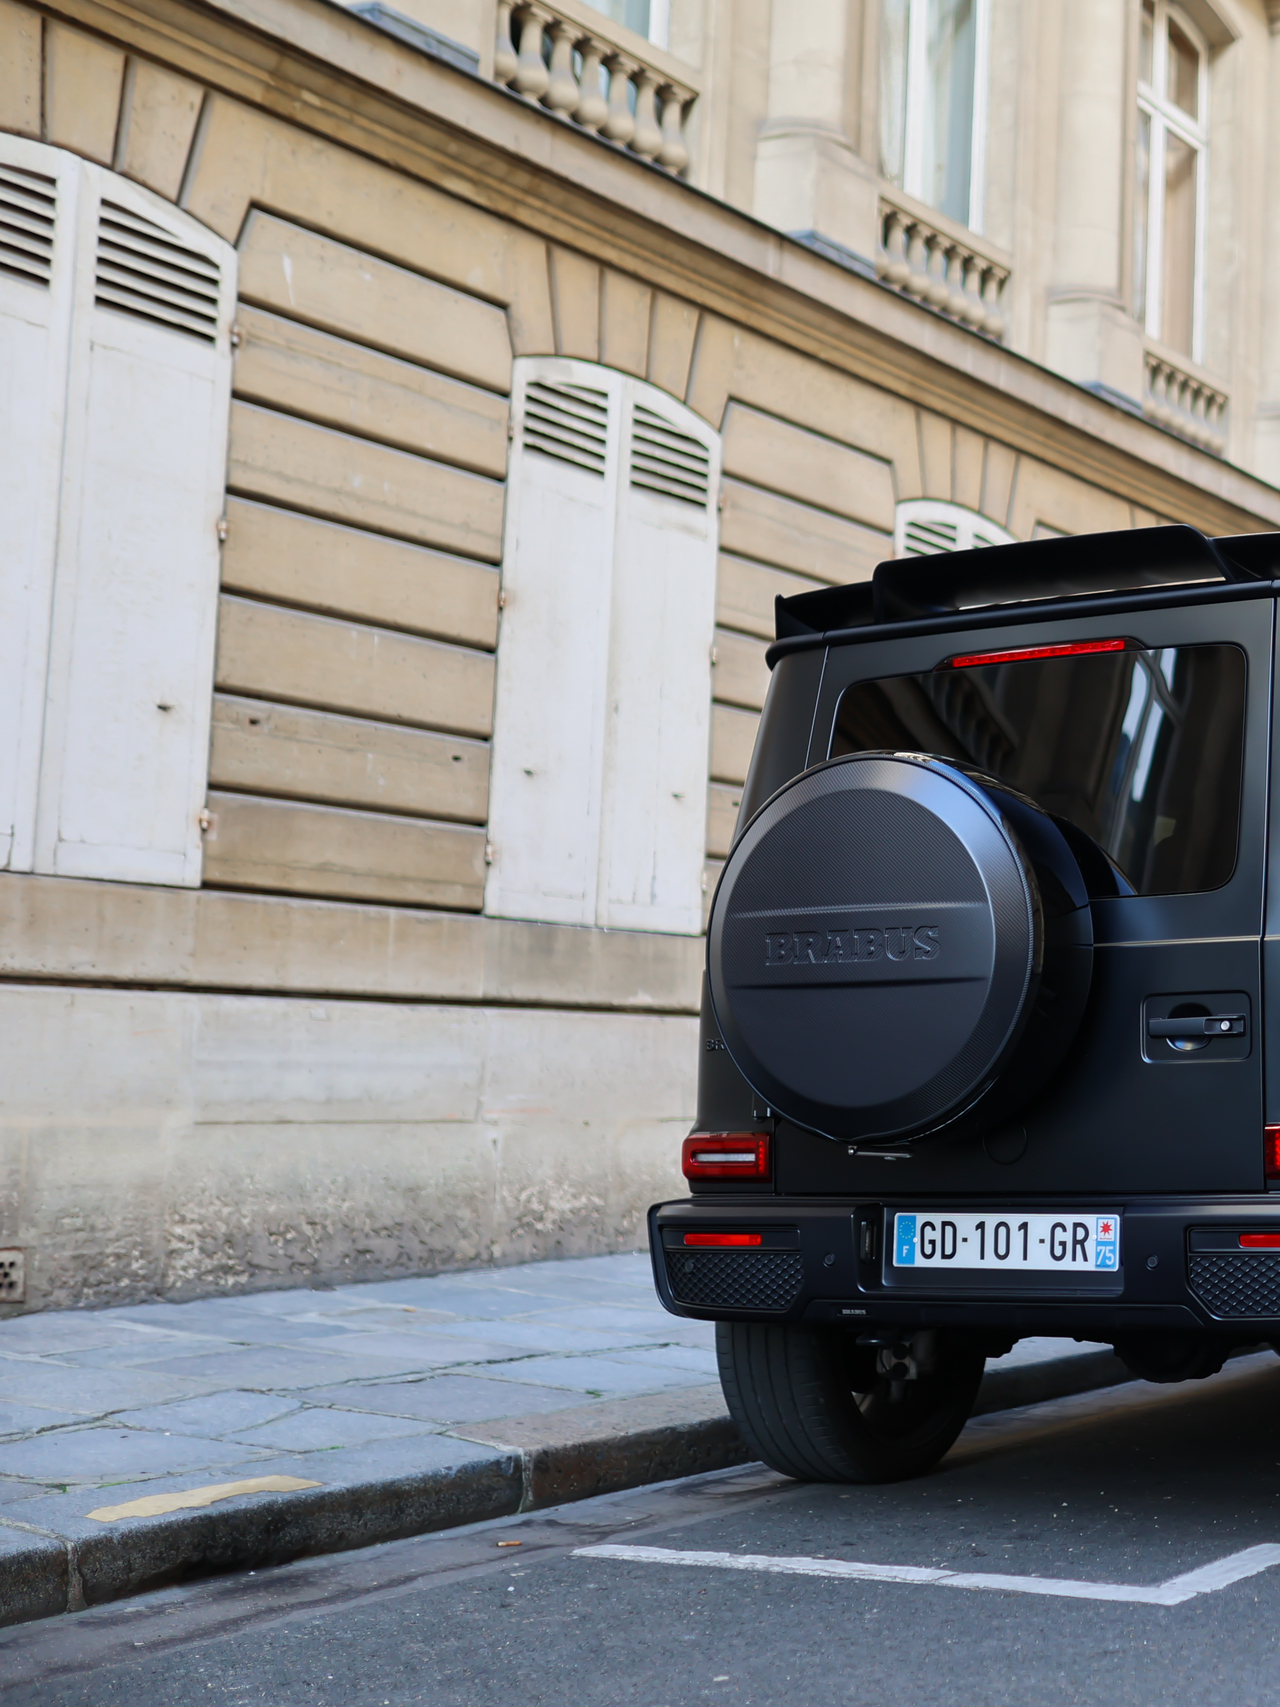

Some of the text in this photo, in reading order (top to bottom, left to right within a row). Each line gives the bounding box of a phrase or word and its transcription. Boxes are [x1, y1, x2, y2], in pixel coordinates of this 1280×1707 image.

[765, 925, 940, 966] BRABUS
[903, 1246, 909, 1257] F
[920, 1220, 1090, 1262] GD-101-GR
[1097, 1246, 1114, 1265] 75
